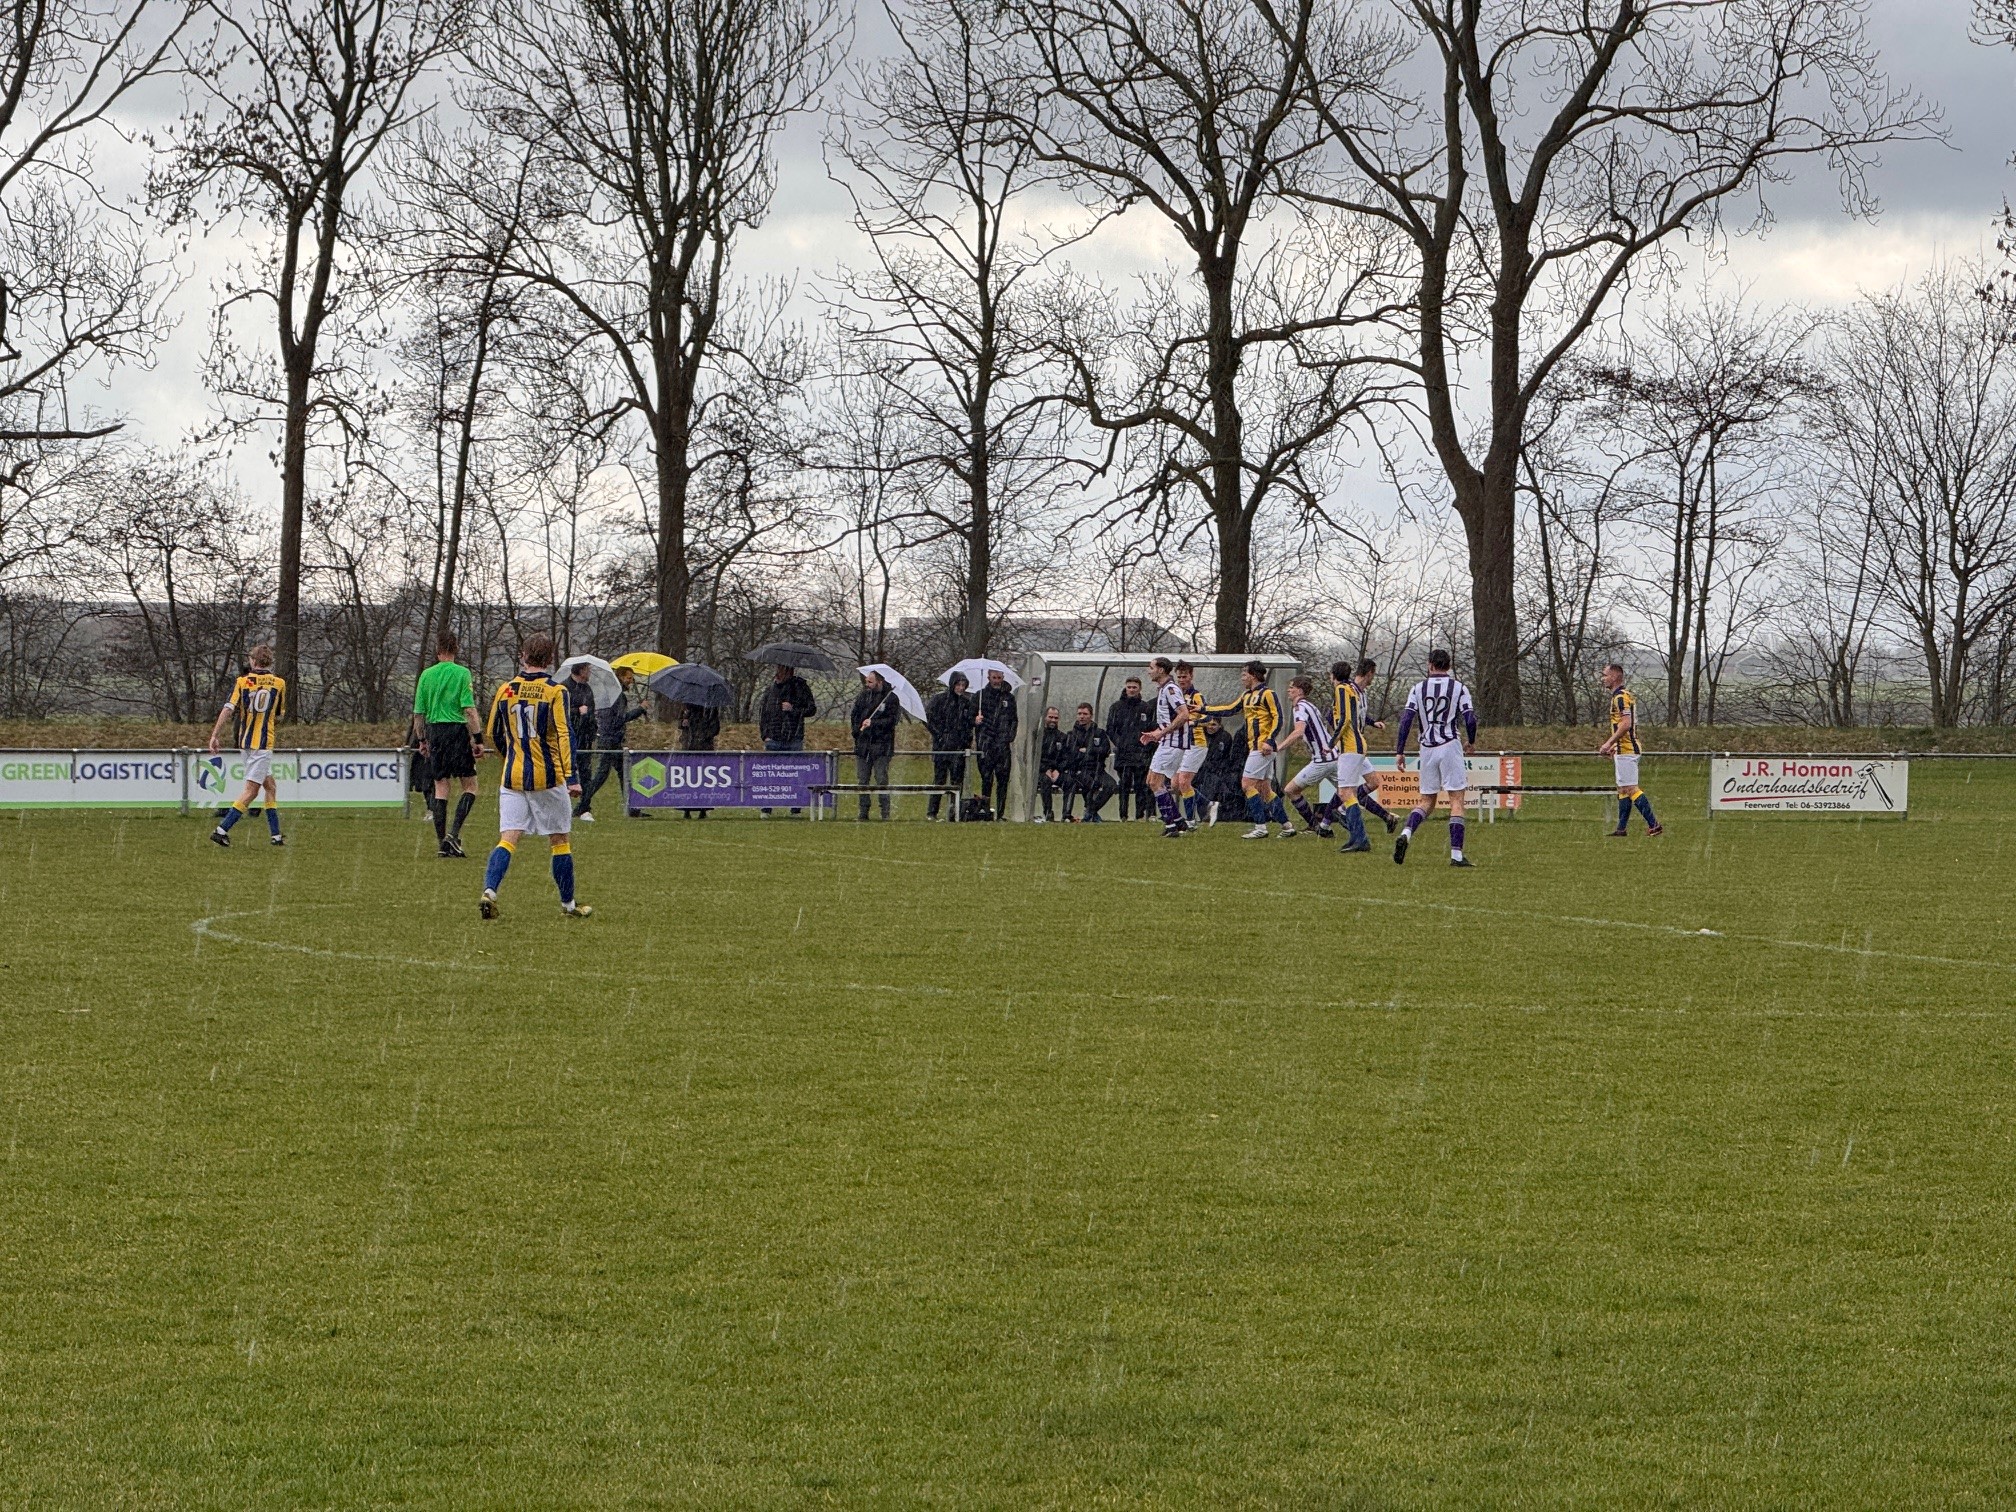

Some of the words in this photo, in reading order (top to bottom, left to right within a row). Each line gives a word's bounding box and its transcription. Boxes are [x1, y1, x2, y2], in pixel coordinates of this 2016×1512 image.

[248, 689, 271, 713] 10
[1424, 695, 1451, 724] 22
[510, 703, 537, 739] 11
[670, 765, 732, 788] BUSS
[771, 763, 811, 771] Harkemaweg
[1742, 761, 1774, 777] J.R.
[1783, 761, 1853, 777] Homan
[1723, 777, 1869, 799] Onderhoudsbedrijf
[1381, 798, 1391, 806] 06
